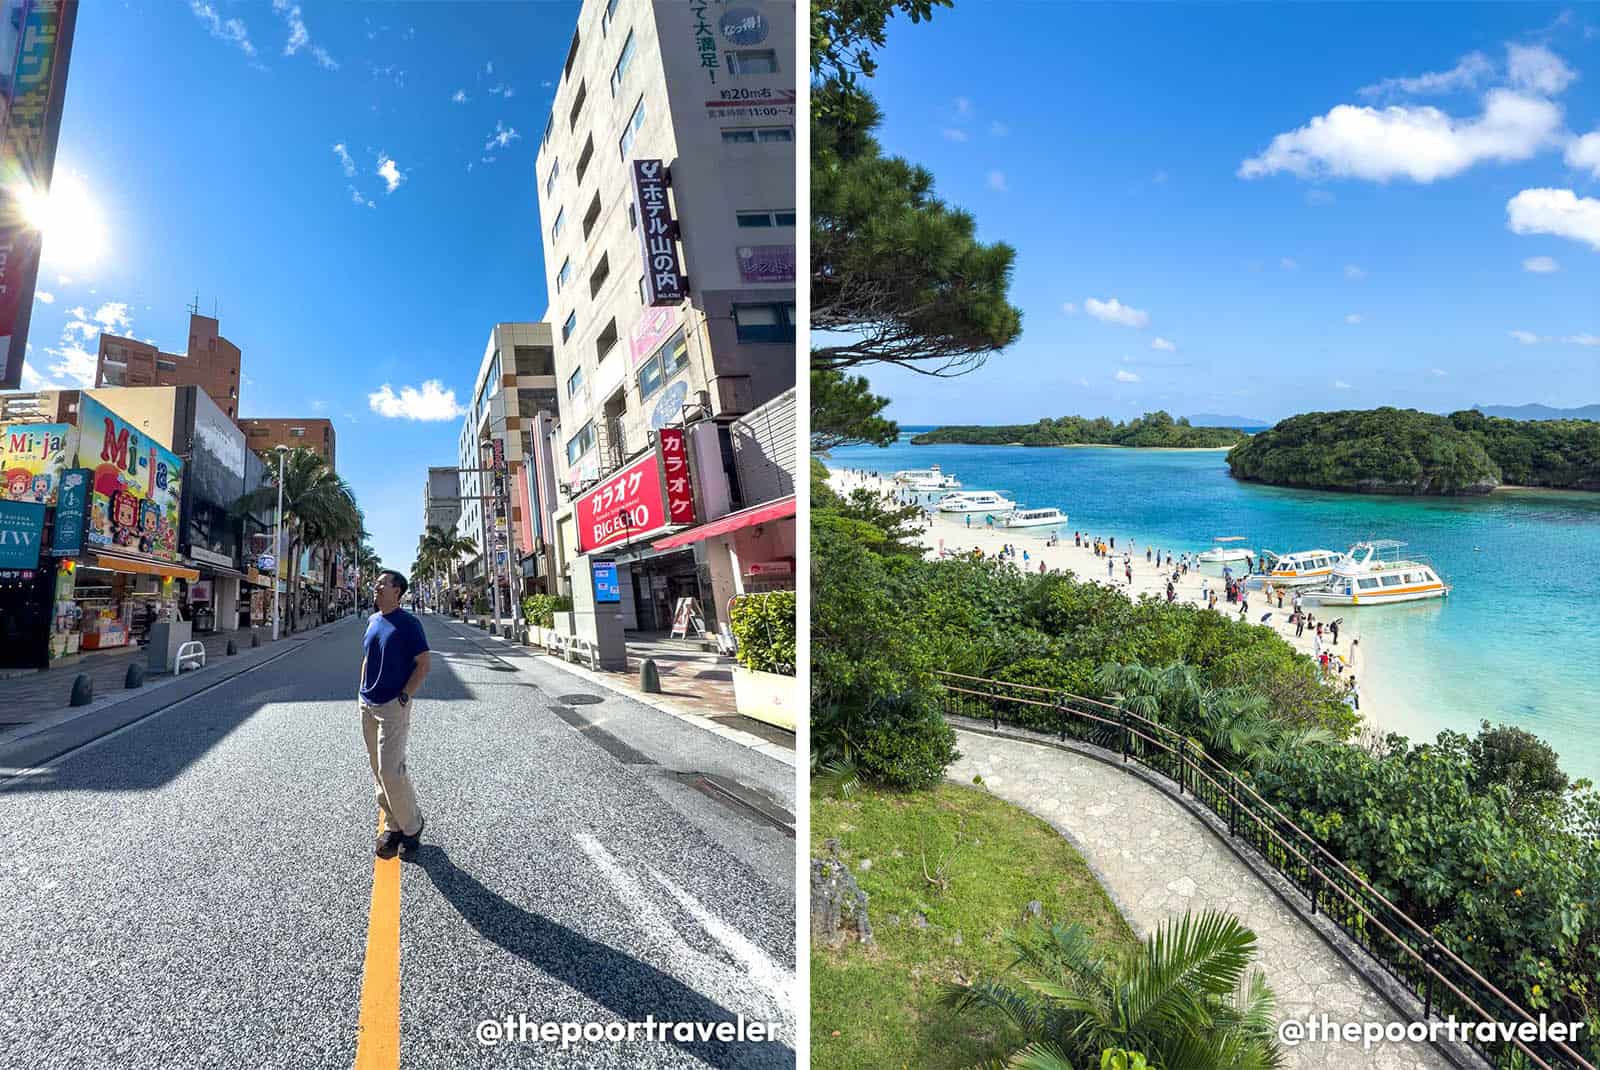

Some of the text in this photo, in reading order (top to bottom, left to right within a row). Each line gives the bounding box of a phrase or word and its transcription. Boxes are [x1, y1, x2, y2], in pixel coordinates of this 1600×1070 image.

[690, 0, 720, 84] て大満足!
[8, 432, 60, 460] Mi-ja
[100, 416, 168, 499] Mi-ja
[663, 436, 690, 515] カラオケ
[592, 472, 642, 515] カラオケ
[593, 519, 613, 543] BIG
[613, 504, 649, 530] ECHO
